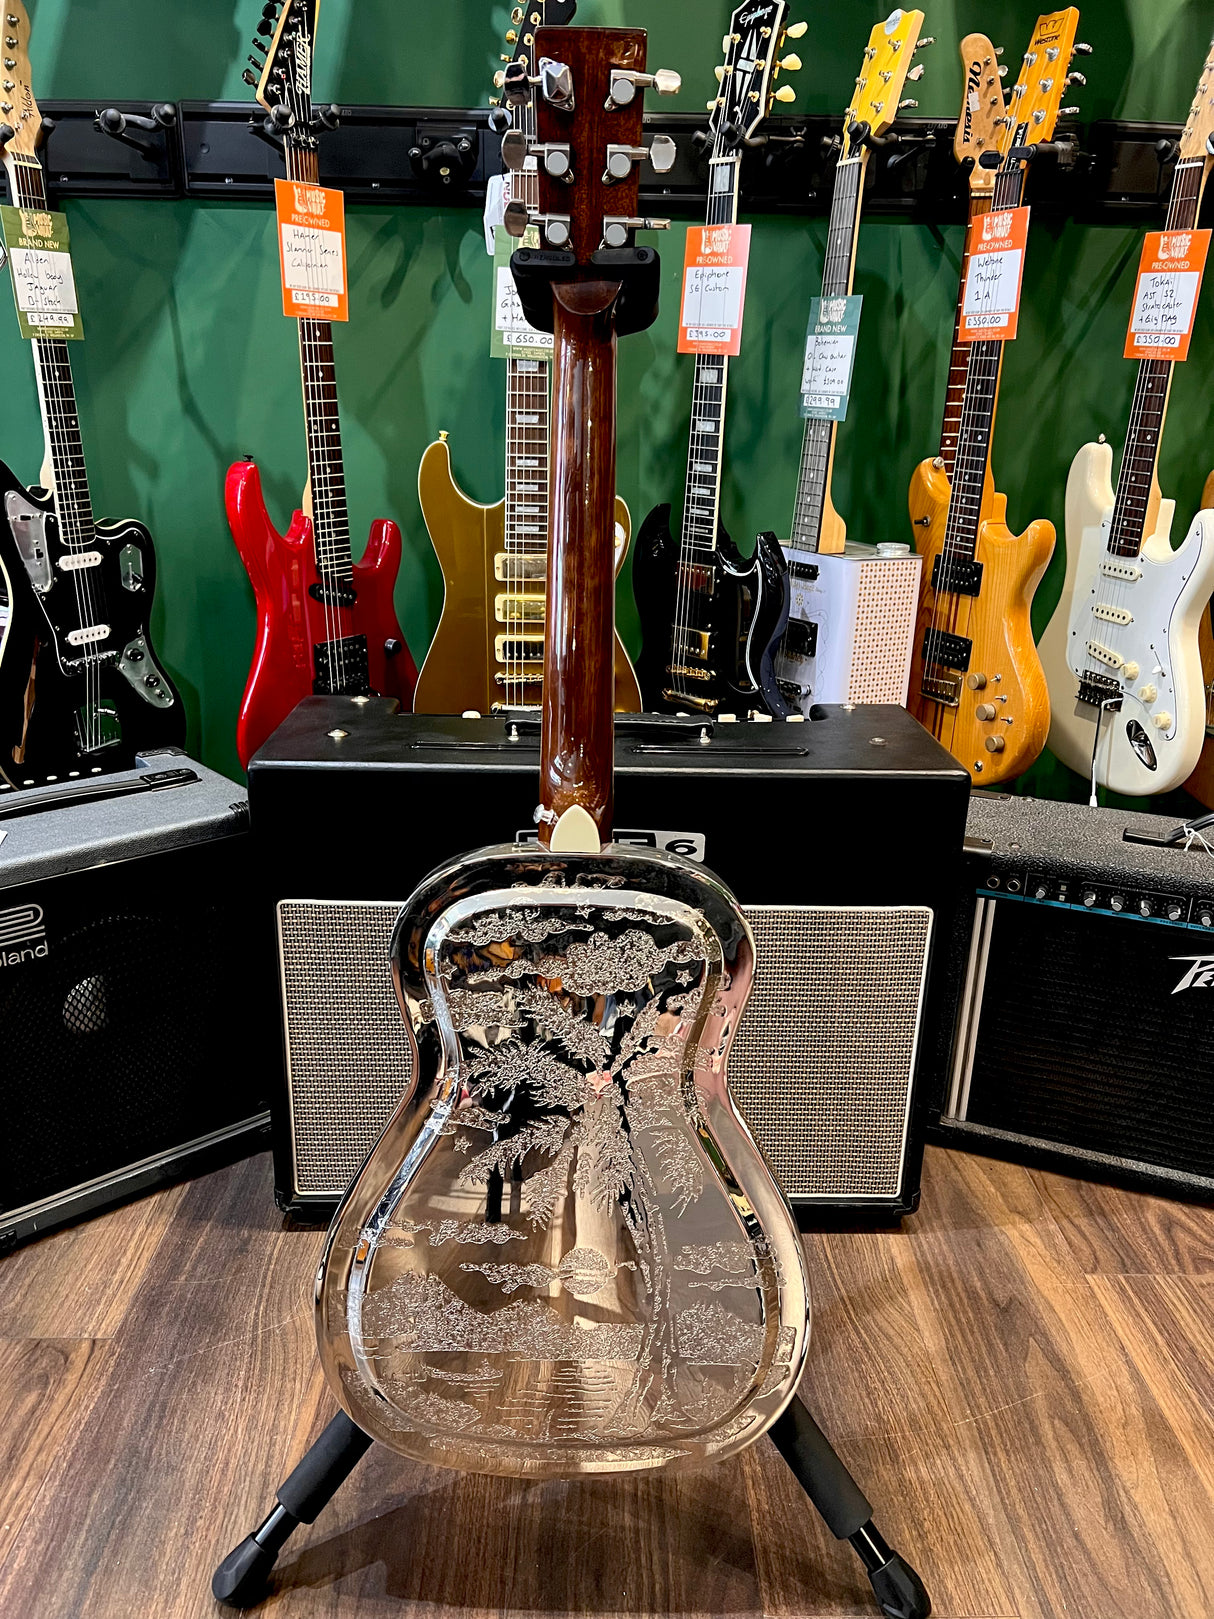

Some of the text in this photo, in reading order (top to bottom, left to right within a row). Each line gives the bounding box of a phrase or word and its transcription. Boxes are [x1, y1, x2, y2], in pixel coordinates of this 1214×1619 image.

[296, 32, 310, 95] HAMER
[19, 238, 59, 249] BRAND NEW
[977, 240, 1013, 252] PRE-OWNED
[696, 255, 733, 264] PRE-OWNED
[1151, 261, 1190, 270] PRE-OWNED
[968, 316, 1001, 327] £350.00
[689, 329, 726, 338] £395.00
[814, 325, 847, 333] BRAND NEW
[507, 334, 553, 345] £650.00
[1136, 335, 1176, 345] £350.00
[664, 839, 698, 857] 6
